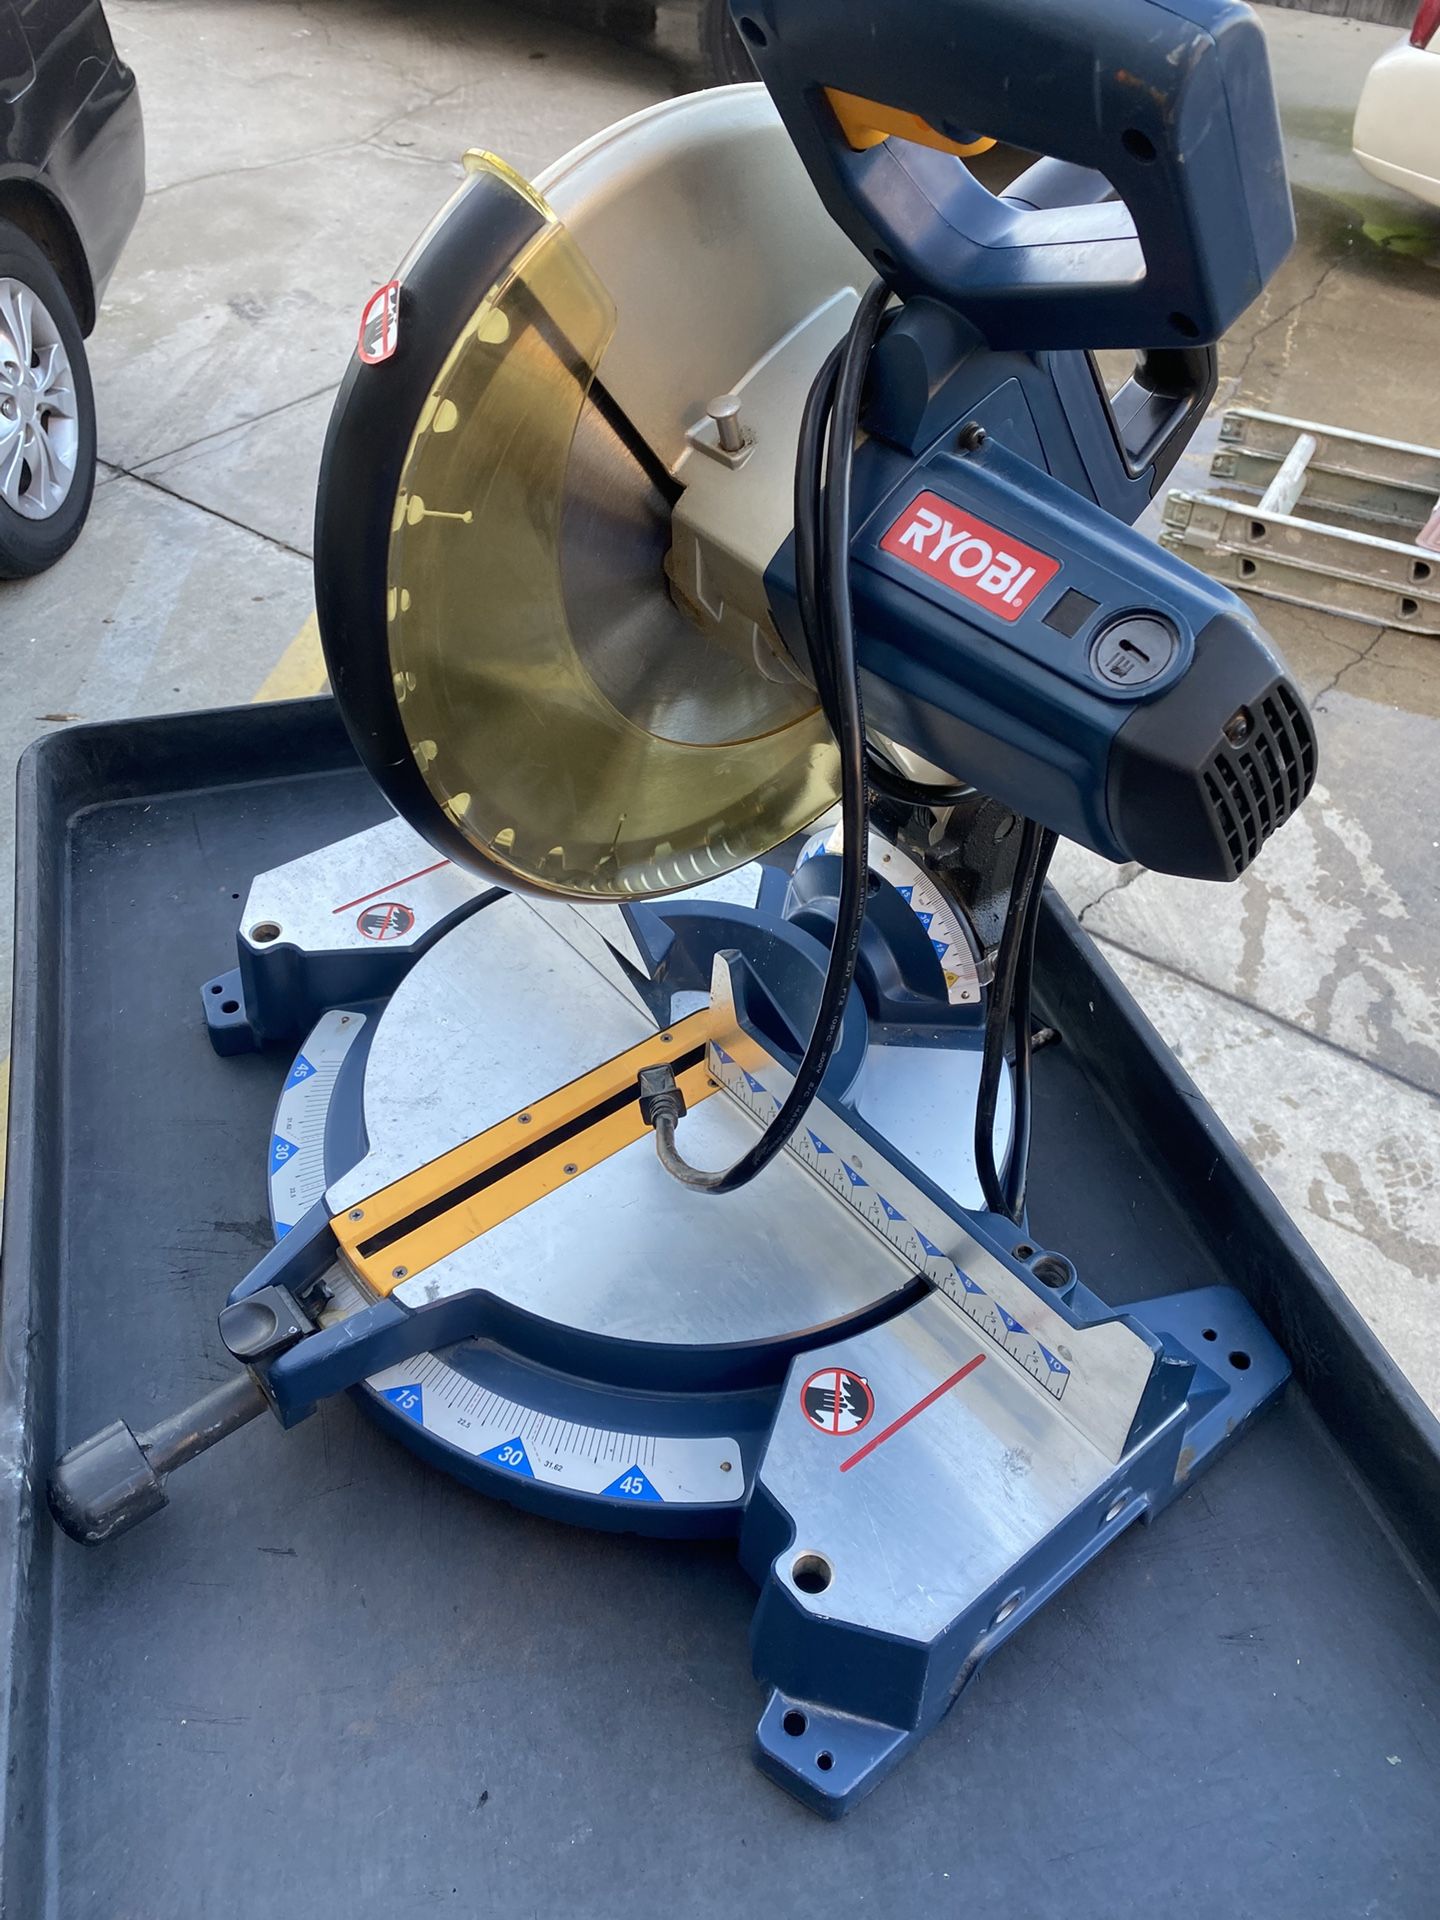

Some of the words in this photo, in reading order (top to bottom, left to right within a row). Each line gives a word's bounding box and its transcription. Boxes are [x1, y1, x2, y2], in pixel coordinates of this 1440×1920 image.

[899, 507, 1036, 604] RYOBI
[900, 887, 911, 898] 45
[920, 914, 930, 924] 30
[935, 943, 945, 954] 15
[294, 1063, 309, 1077] 45
[275, 1143, 290, 1160] 30
[815, 1140, 823, 1149] 4
[850, 1171, 857, 1182] 5
[886, 1206, 894, 1216] 6
[965, 1279, 972, 1289] 8
[1006, 1317, 1014, 1327] 9
[1049, 1356, 1062, 1370] 10
[396, 1389, 419, 1409] 15
[457, 1418, 472, 1429] 22.5
[498, 1446, 523, 1466] 30
[543, 1460, 564, 1473] 31.62
[619, 1476, 643, 1495] 45
